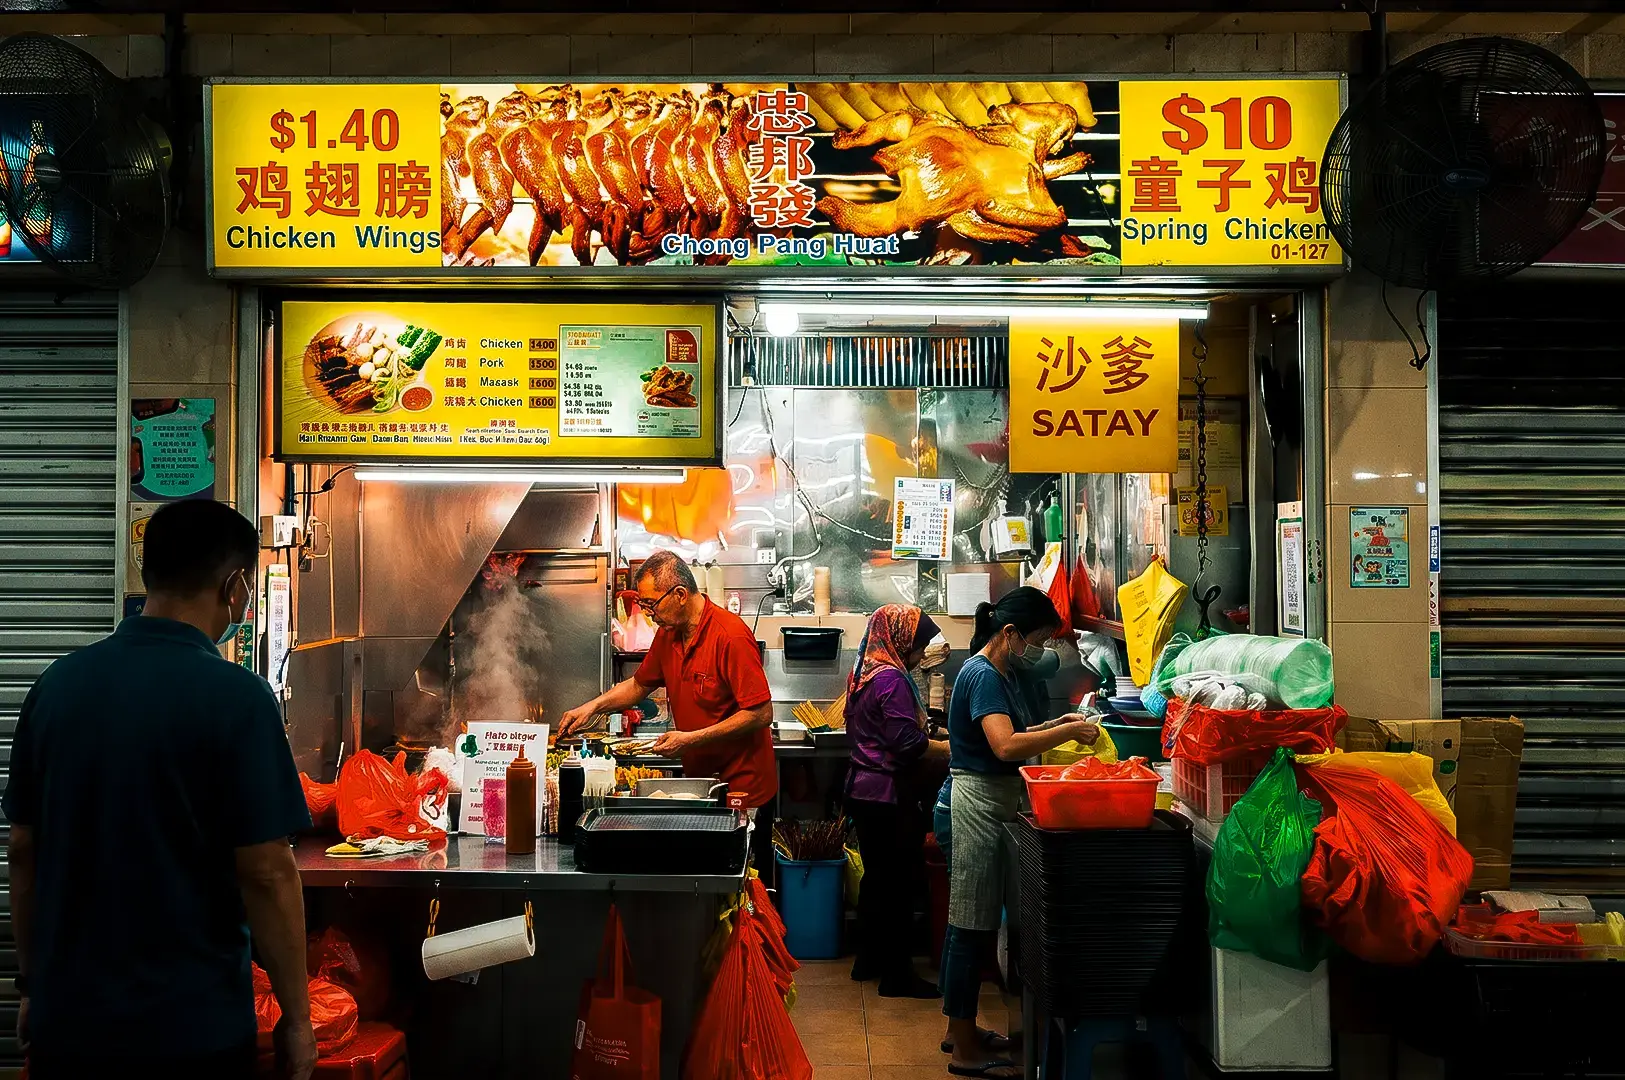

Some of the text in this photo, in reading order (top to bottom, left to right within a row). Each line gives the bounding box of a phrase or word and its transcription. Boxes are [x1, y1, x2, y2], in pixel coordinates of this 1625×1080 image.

[270, 109, 399, 153] $1.40
[1162, 93, 1292, 155] $10
[749, 89, 816, 228] 忠邦發
[235, 160, 431, 219] 鸡翅膀
[1128, 156, 1320, 213] 童子鸡
[226, 225, 441, 253] Chicken Wings
[1123, 218, 1330, 245] Spring Chicken
[662, 234, 899, 259] Chong Pang Huat
[1271, 243, 1329, 260] 01-127
[480, 338, 523, 349] Chicken
[480, 358, 504, 368] Pork
[1036, 335, 1155, 394] 沙爹
[480, 396, 523, 407] Chicken
[1032, 408, 1160, 437] SATAY
